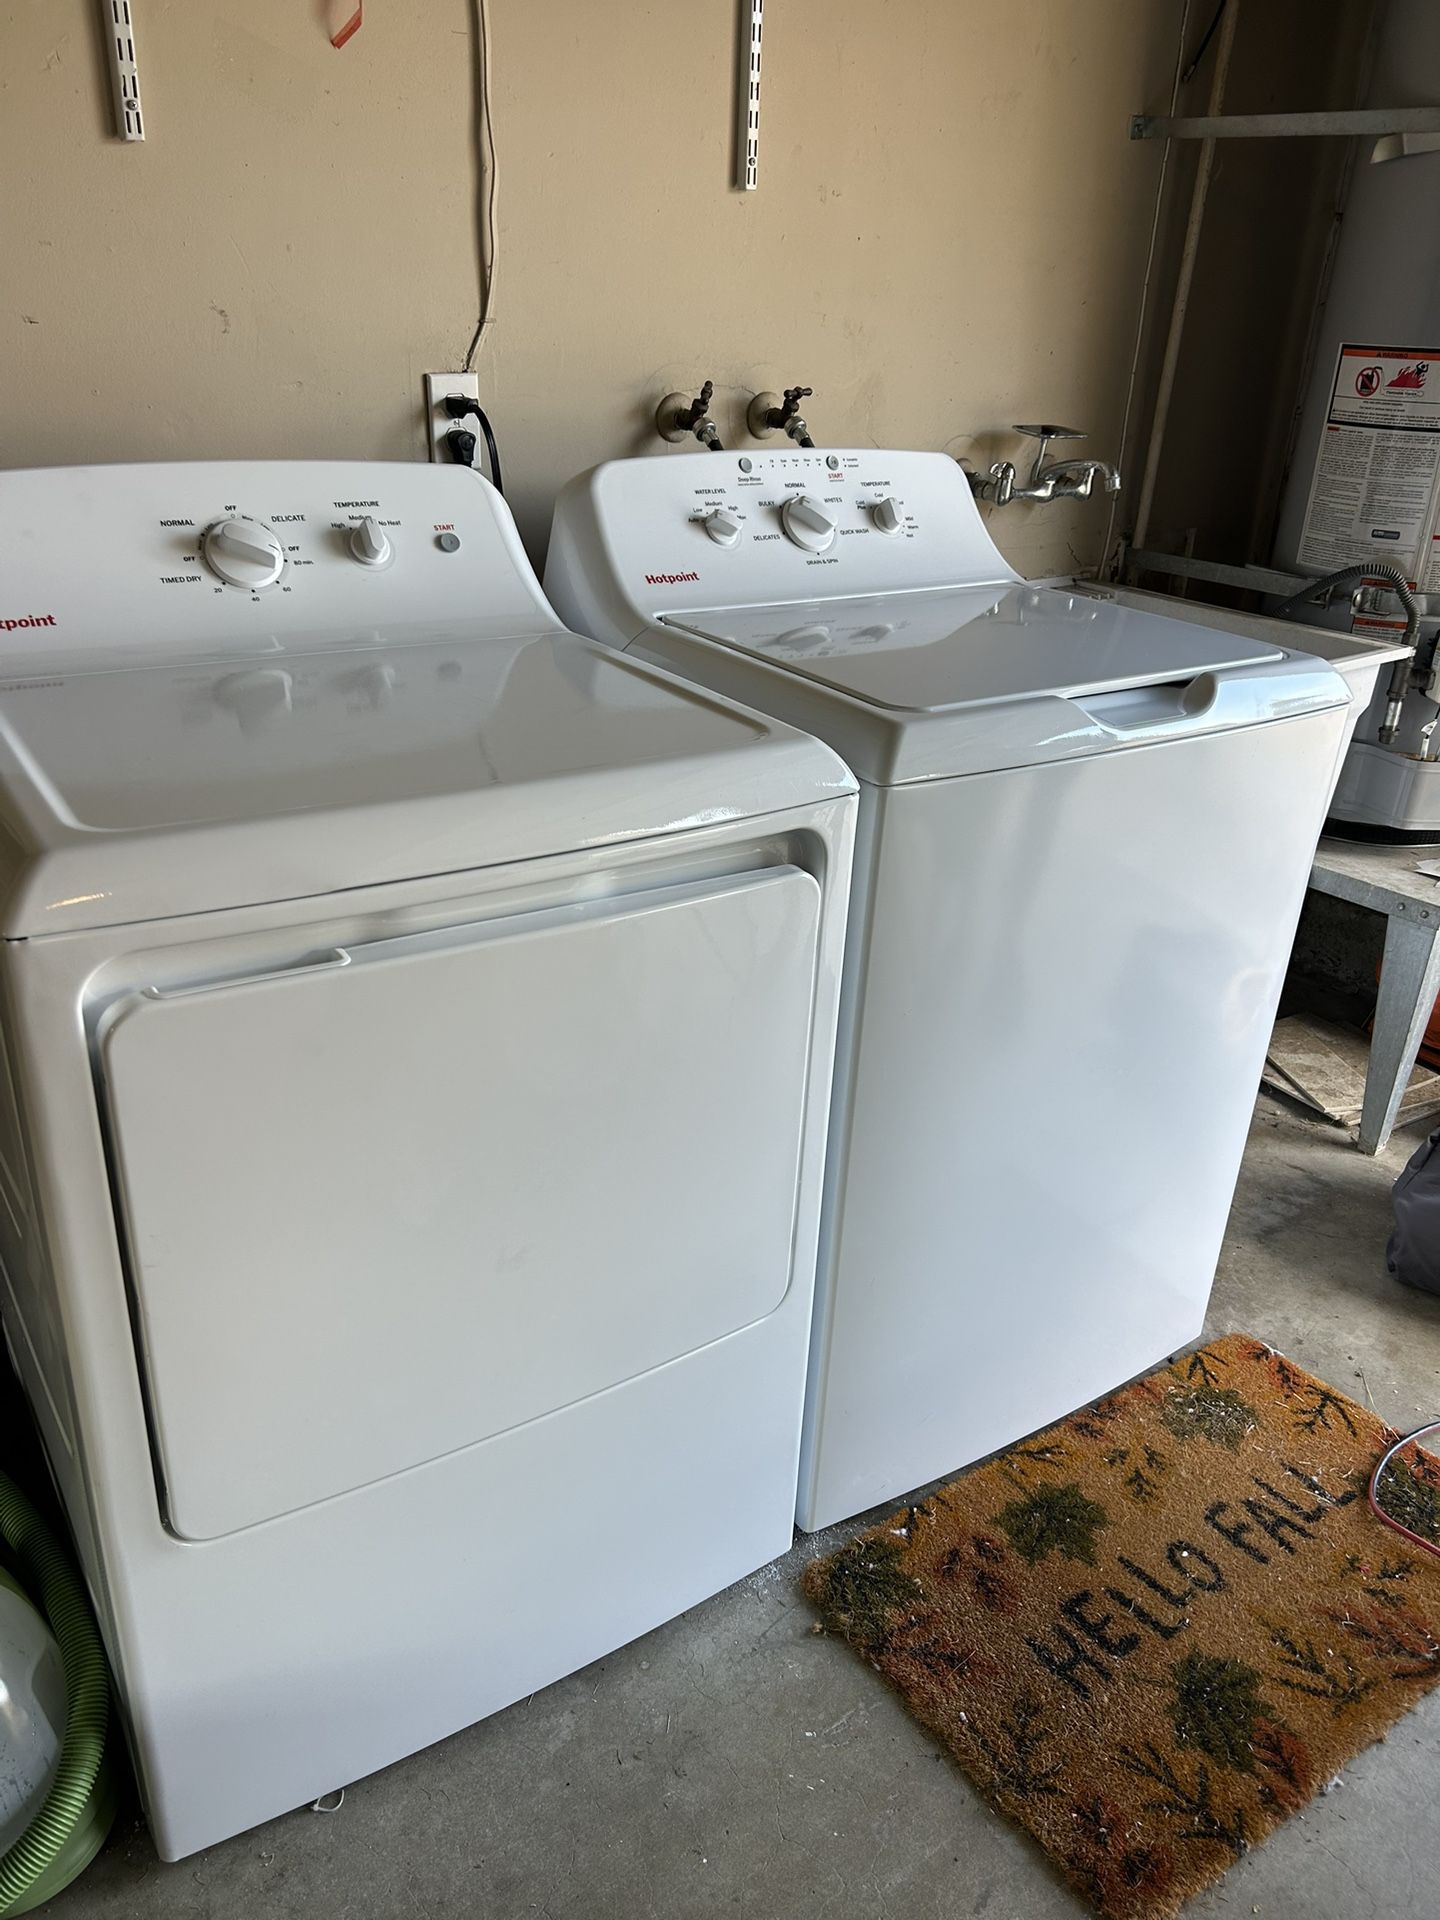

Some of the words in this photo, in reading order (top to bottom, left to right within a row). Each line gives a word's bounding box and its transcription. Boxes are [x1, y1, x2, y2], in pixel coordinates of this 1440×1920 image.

[160, 519, 195, 527] NORMAL
[271, 514, 306, 523] DELICATE
[160, 576, 185, 584] TIMED
[645, 571, 700, 584] Hotpoint
[1024, 1539, 1228, 1700] HELLO
[1203, 1459, 1358, 1565] FALL
